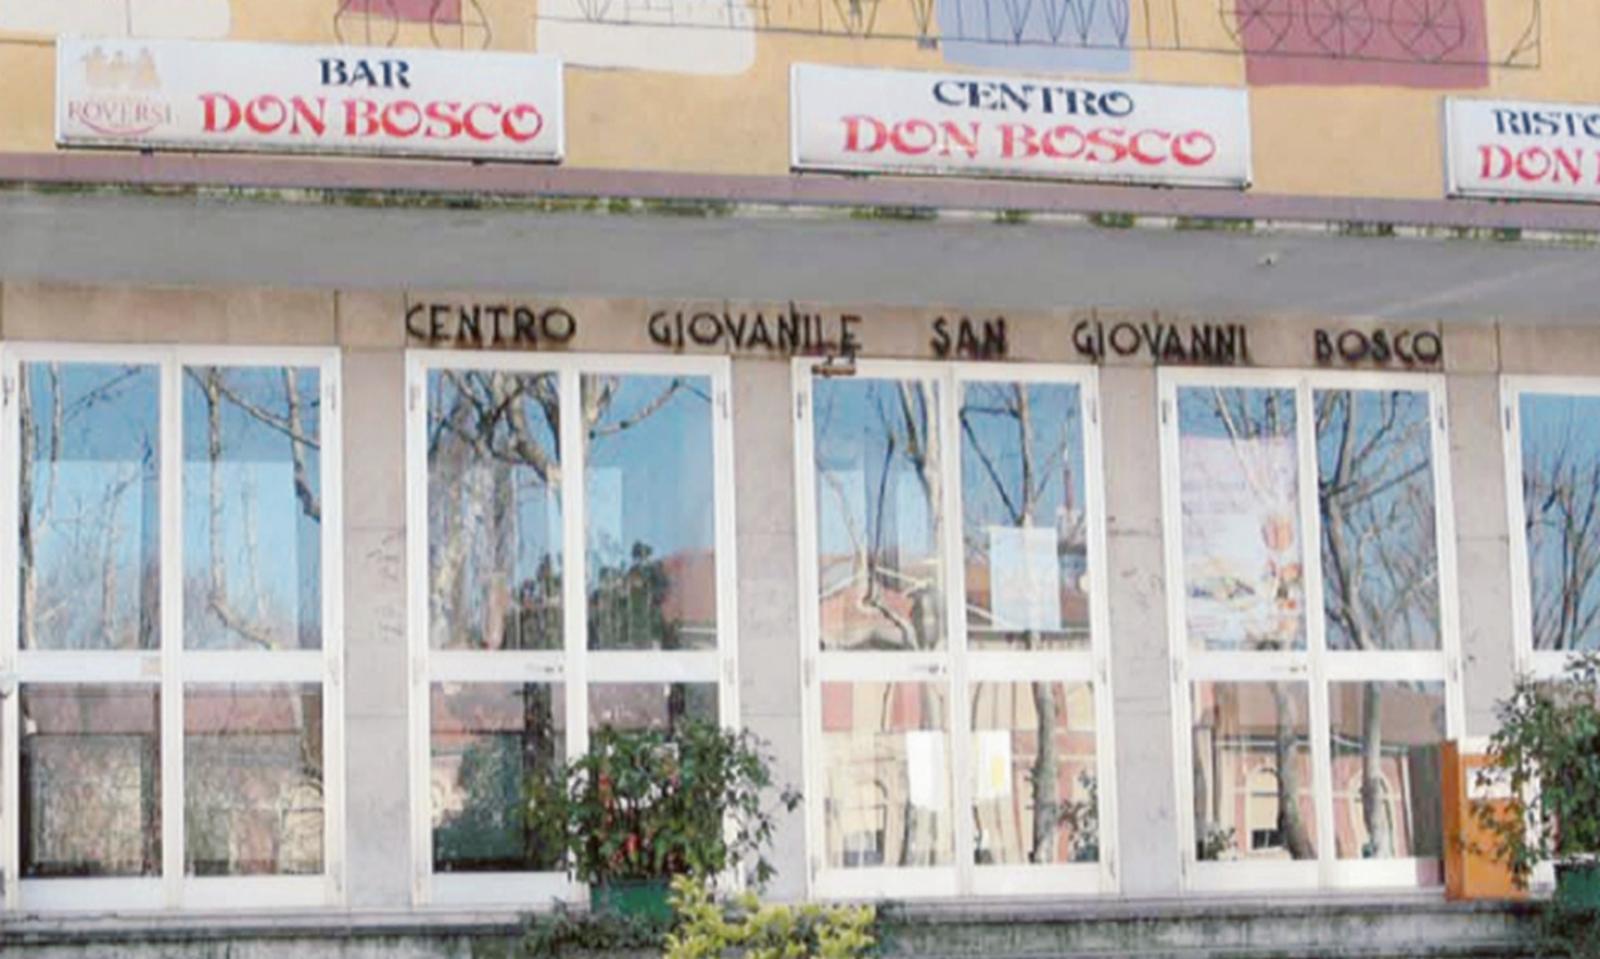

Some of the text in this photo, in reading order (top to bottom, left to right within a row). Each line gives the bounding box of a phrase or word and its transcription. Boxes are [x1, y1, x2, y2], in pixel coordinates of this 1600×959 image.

[319, 57, 411, 88] BAR
[199, 92, 543, 142] DON BOSCO
[932, 79, 1134, 116] CENTRO
[841, 115, 1216, 166] DON BOSCO
[1478, 144, 1583, 184] DON
[405, 304, 1442, 367] CENTRO GIOVANILE SAN GIOVANNI BOSCO
